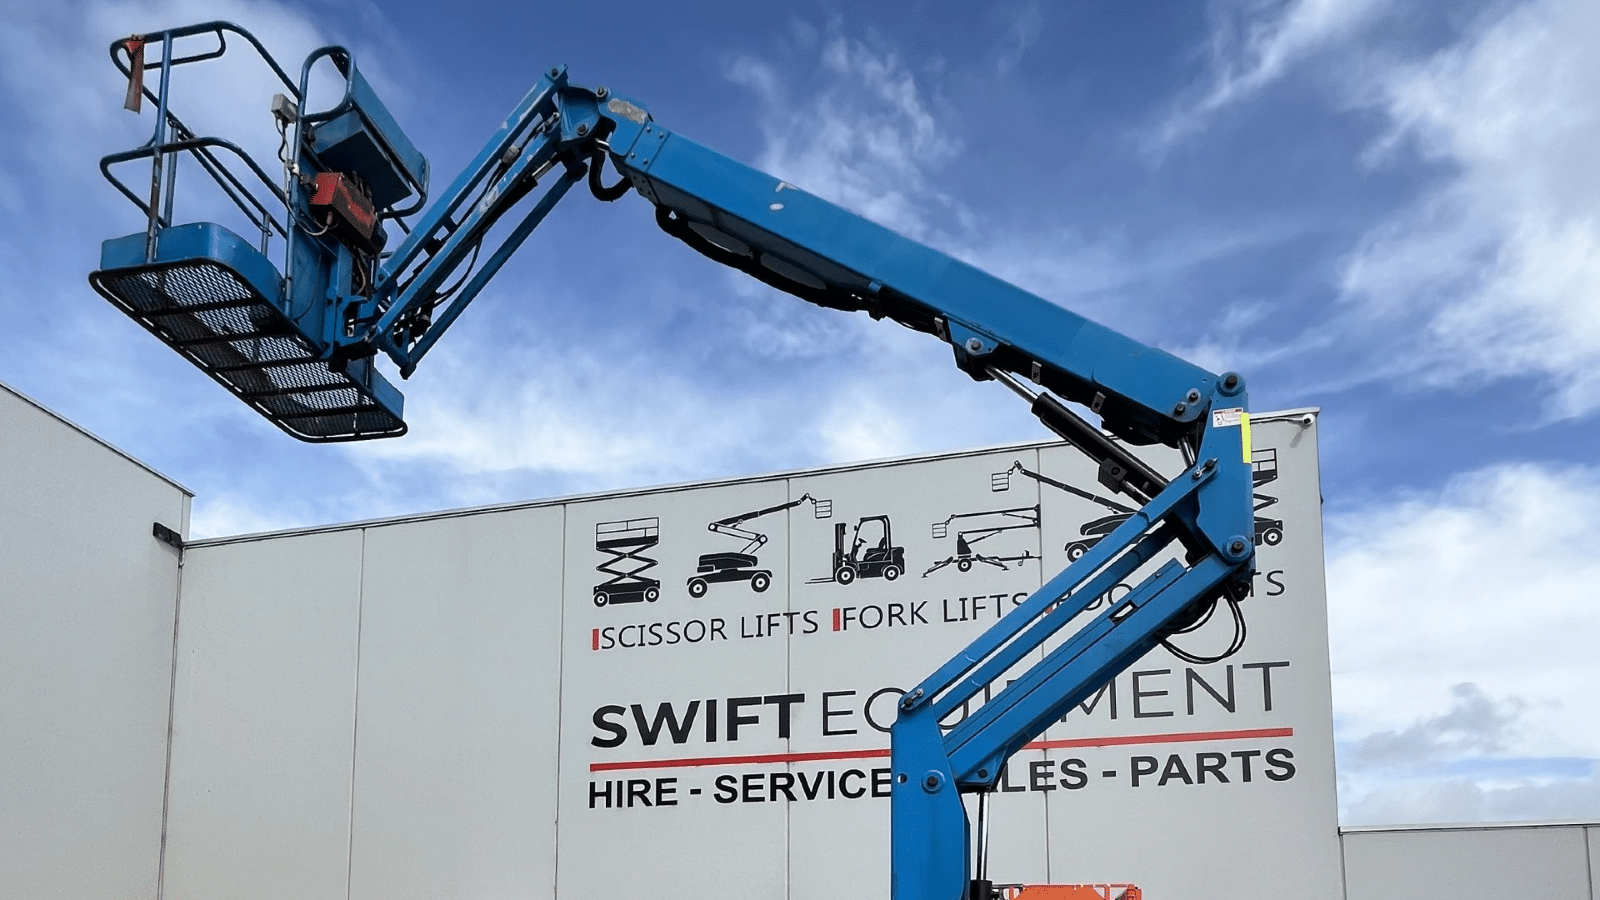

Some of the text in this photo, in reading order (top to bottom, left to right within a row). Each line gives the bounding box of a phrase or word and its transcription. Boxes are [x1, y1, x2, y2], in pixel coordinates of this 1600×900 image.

[601, 618, 728, 650] SCISSOR
[741, 610, 819, 639] LIFTS
[843, 600, 929, 631] FORK
[590, 693, 806, 749] SWIFT
[588, 777, 679, 809] HIRE
[713, 767, 892, 804] SERVICE
[1130, 748, 1296, 788] PARTS
